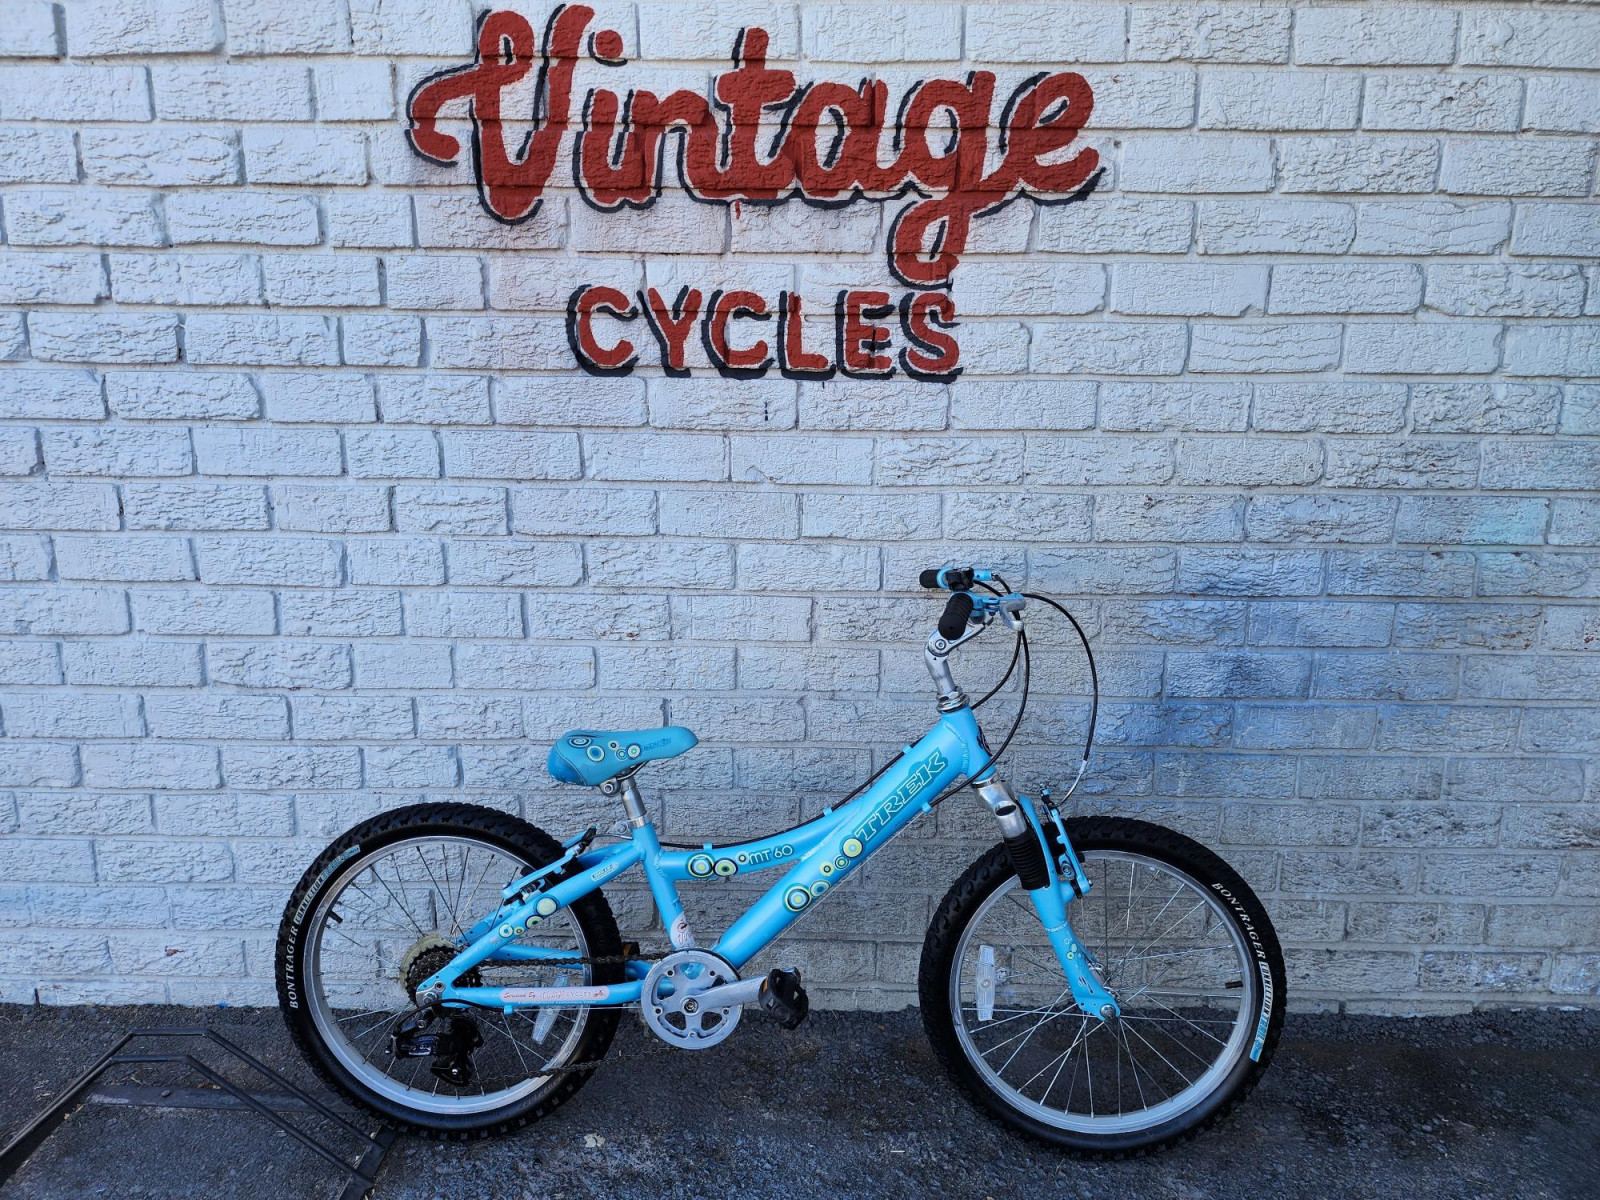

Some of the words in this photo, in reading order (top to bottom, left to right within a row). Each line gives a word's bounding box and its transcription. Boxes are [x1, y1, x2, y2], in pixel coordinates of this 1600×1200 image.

[406, 4, 1106, 290] Vintage
[566, 284, 963, 384] CYCLES
[854, 752, 946, 841] TREK
[774, 845, 793, 858] 60
[1211, 882, 1266, 959] BONTRAGER
[285, 925, 299, 1009] BONTRAGER
